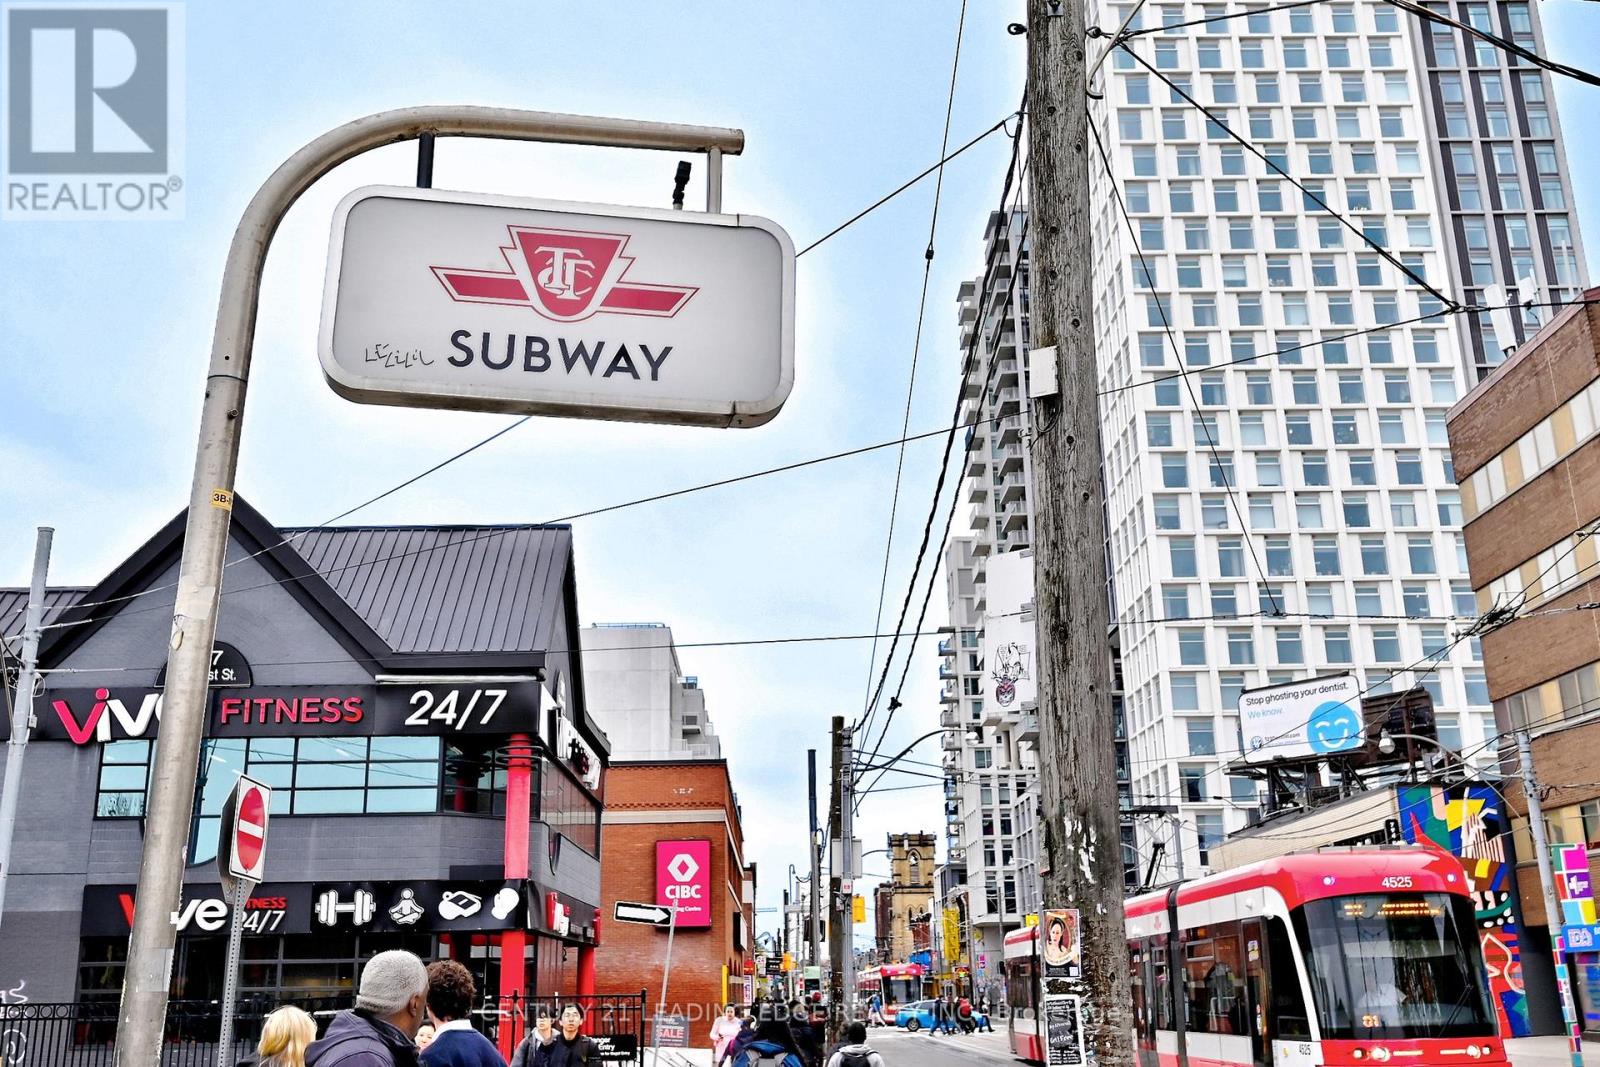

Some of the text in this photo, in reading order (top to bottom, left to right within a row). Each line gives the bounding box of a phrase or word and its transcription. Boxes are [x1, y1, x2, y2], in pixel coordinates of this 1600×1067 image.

[447, 329, 673, 382] SUBWAY
[211, 650, 224, 666] 7
[221, 668, 237, 681] St.
[1246, 696, 1264, 706] Stop
[1265, 691, 1299, 705] ghosting
[1300, 688, 1317, 699] your
[52, 688, 507, 744] viv FITNESS 24/7
[1248, 710, 1260, 719] We
[1382, 876, 1413, 888] 4525
[665, 885, 702, 899] CIBC
[655, 1029, 684, 1039] SALE
[1298, 1043, 1312, 1056] 4525
